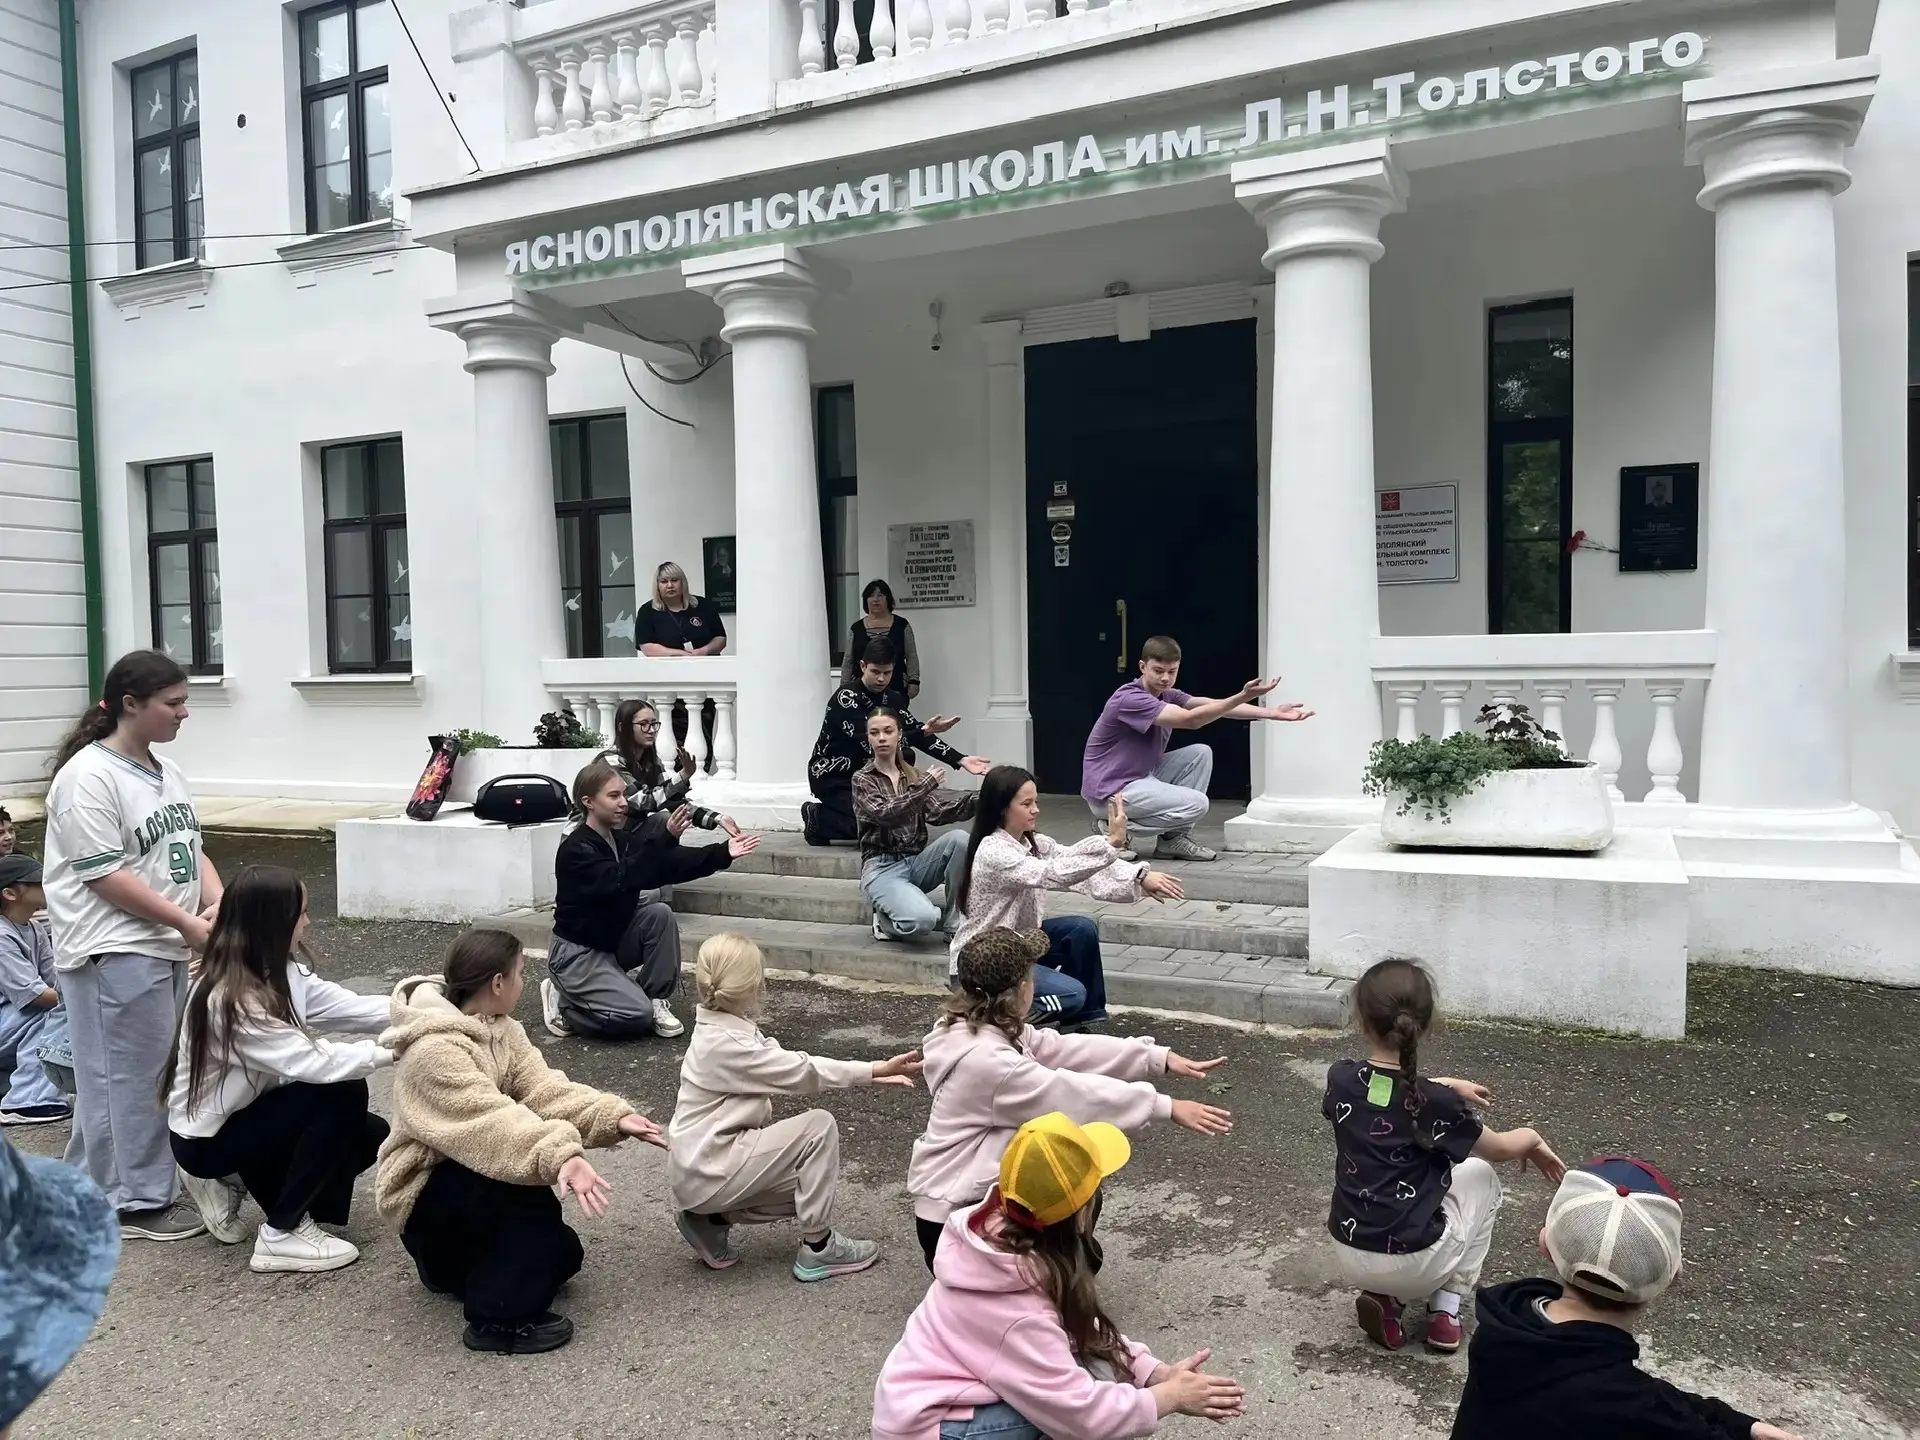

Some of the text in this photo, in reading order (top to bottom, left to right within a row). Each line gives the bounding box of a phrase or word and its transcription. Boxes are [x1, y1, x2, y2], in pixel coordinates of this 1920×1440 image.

[505, 173, 895, 276] ЯСНОПОЛЯНСКАЯ
[908, 134, 1106, 204] ШКОЛА
[1125, 125, 1220, 168] им.
[1410, 548, 1451, 556] КОМПЛЕКС
